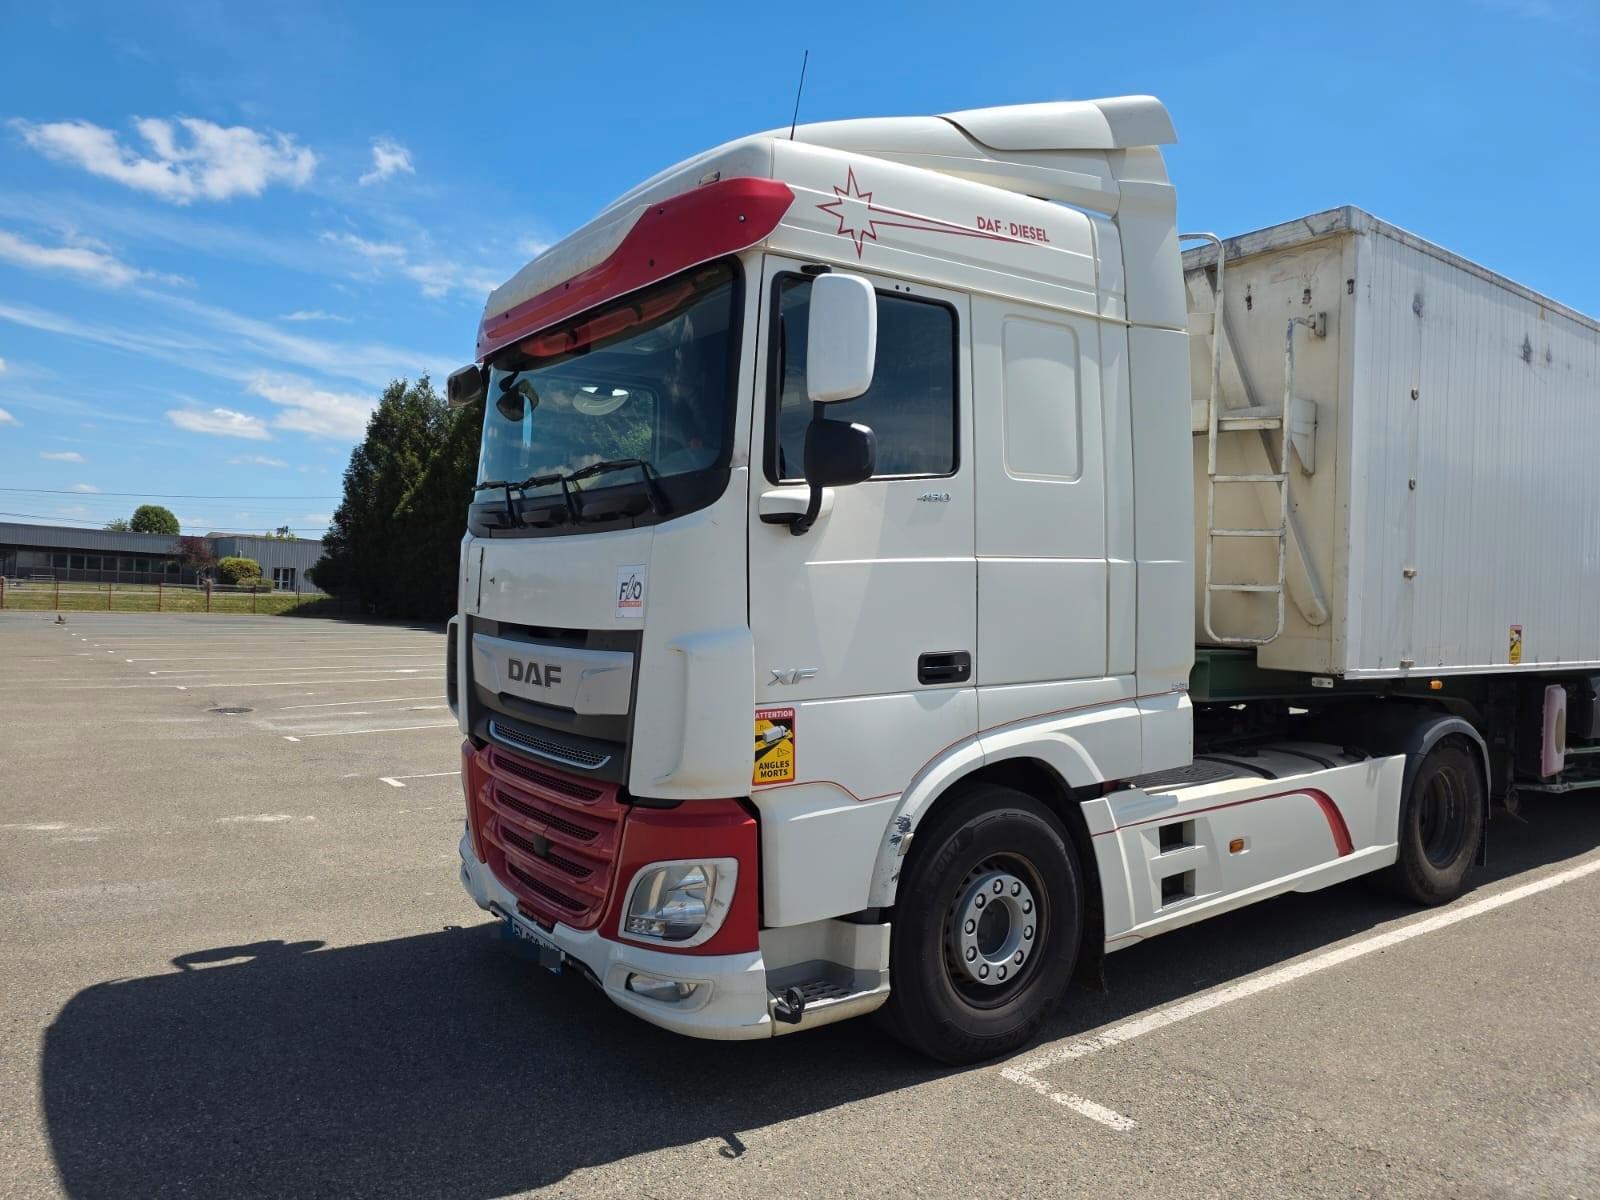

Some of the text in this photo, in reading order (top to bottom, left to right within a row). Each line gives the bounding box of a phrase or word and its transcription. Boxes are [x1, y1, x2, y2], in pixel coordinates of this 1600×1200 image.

[977, 216, 1001, 232] DAF
[1010, 222, 1050, 242] DIESEL
[508, 659, 562, 688] DAF
[768, 667, 818, 686] XF
[755, 710, 793, 719] ATTENTION
[759, 760, 790, 771] ANGLES
[760, 768, 789, 779] MORTS
